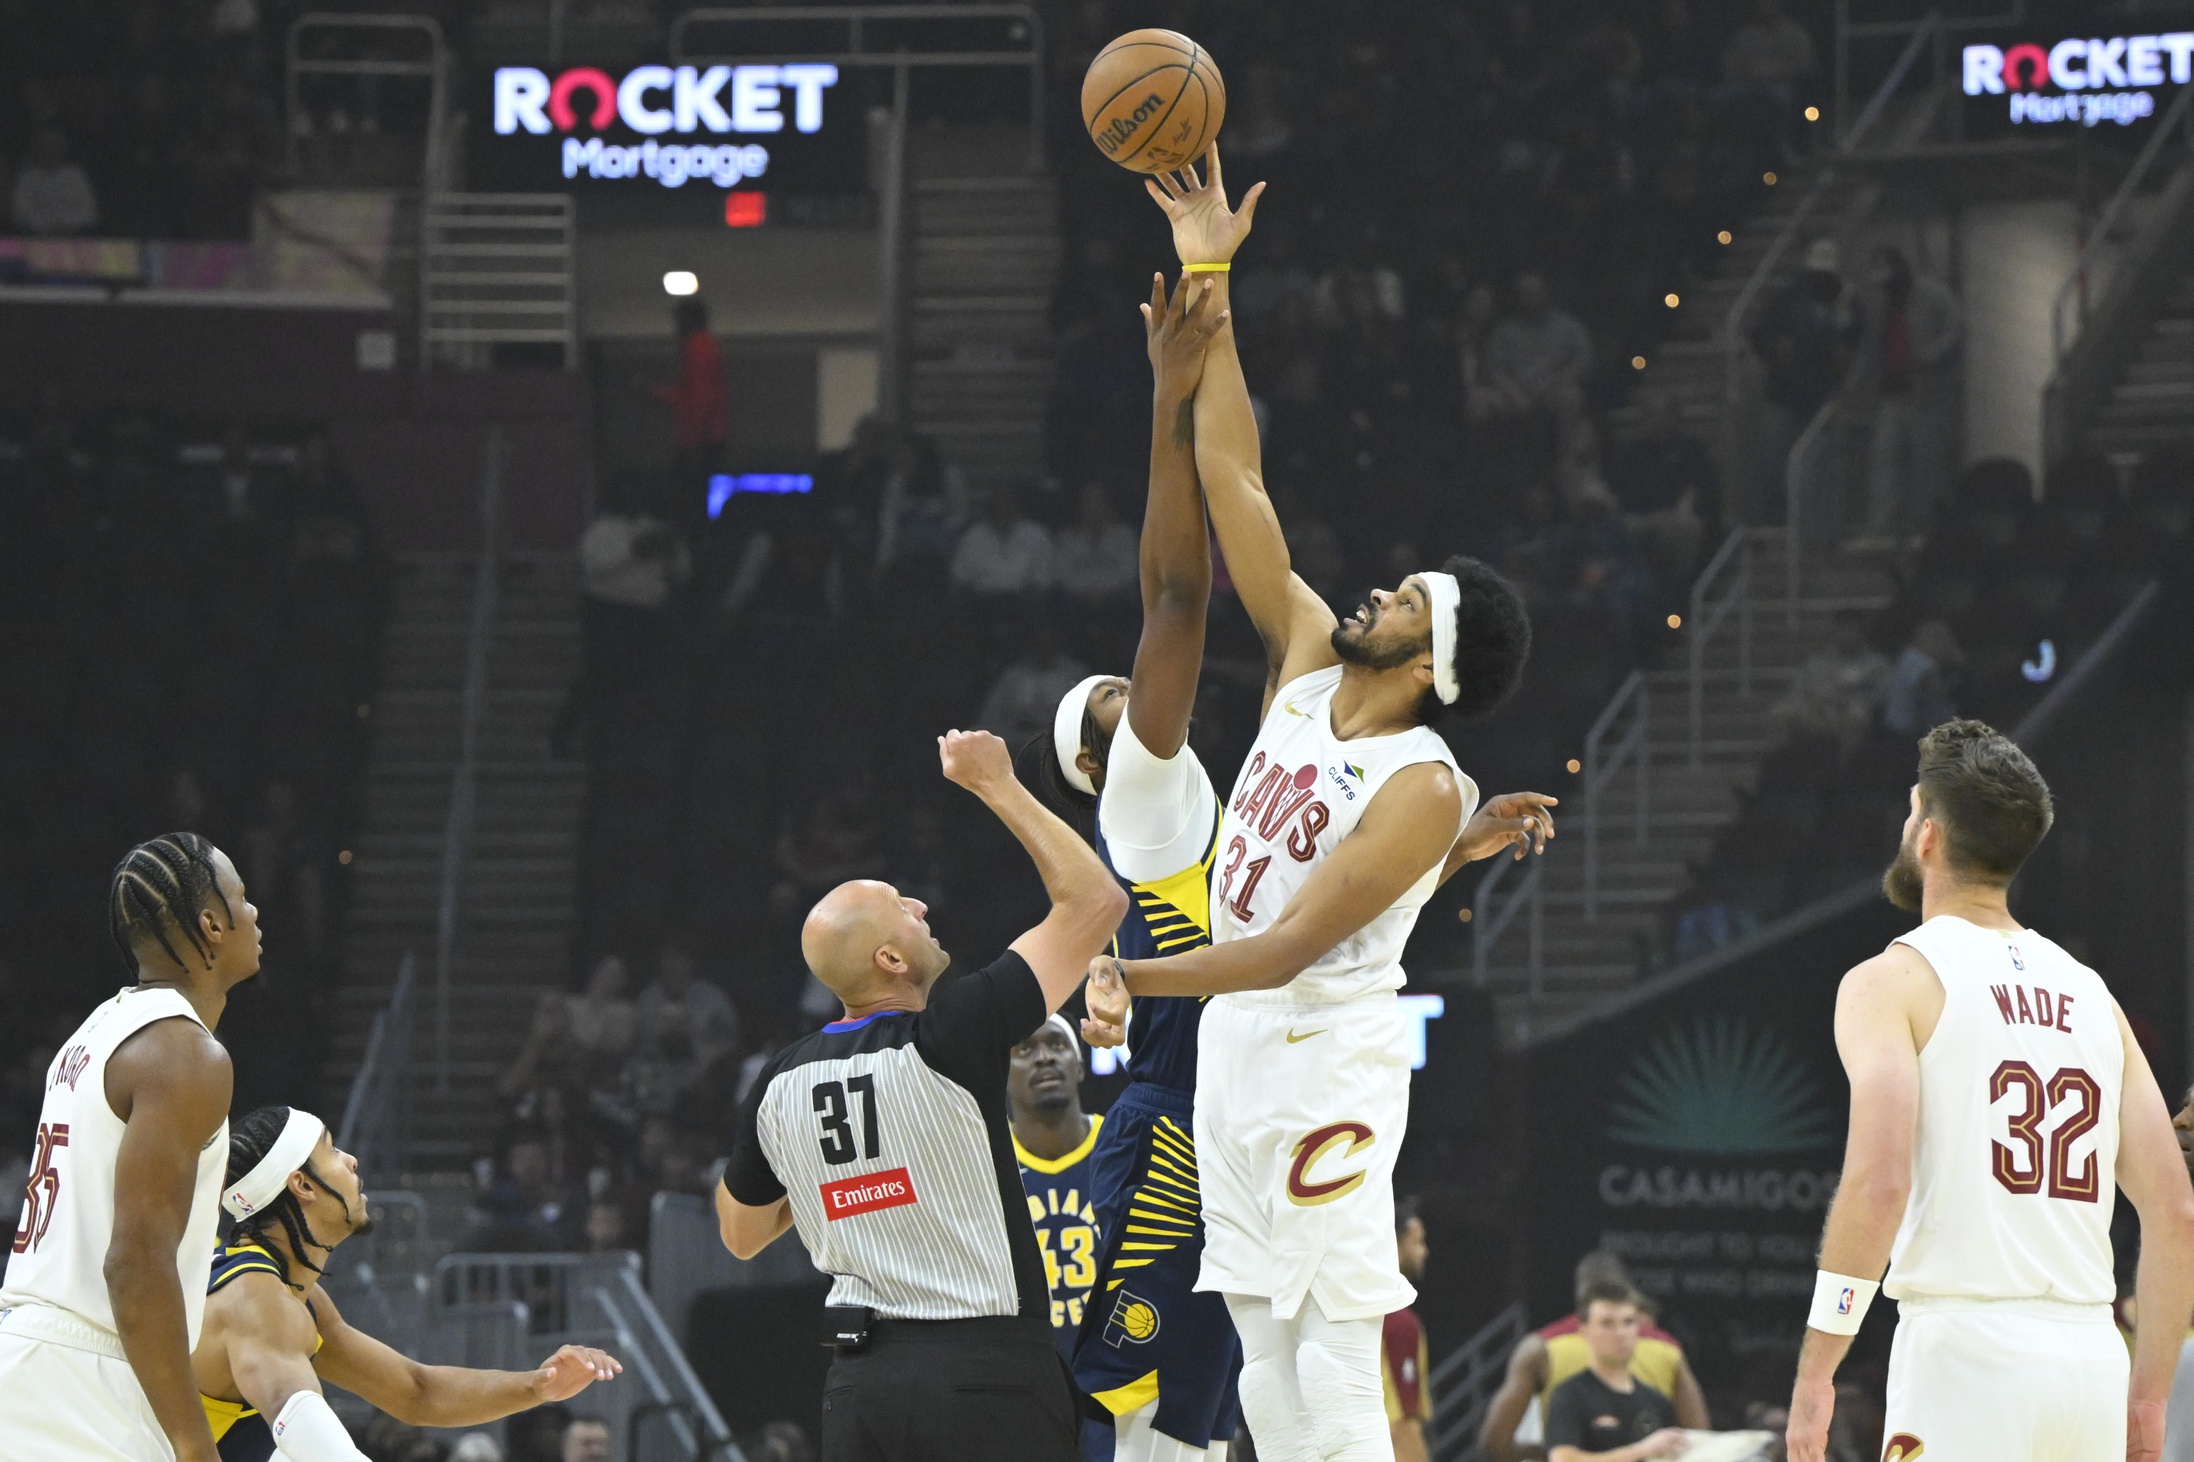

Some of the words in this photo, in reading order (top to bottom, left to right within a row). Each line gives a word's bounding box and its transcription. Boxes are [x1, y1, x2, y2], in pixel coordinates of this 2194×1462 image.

[1962, 31, 2194, 96] ROCKET
[493, 64, 839, 135] ROCKET
[1096, 92, 1166, 155] Wilson
[2010, 90, 2155, 128] Mortgage
[562, 137, 769, 188] Mortgage
[1233, 750, 1330, 862] CAVS
[1328, 766, 1355, 801] CLIFFS
[1219, 834, 1271, 924] 31
[1990, 984, 2074, 1034] WADE
[812, 1073, 880, 1165] 37
[1990, 1060, 2101, 1203] 32
[13, 1123, 69, 1254] 35
[831, 1181, 905, 1208] Emirates
